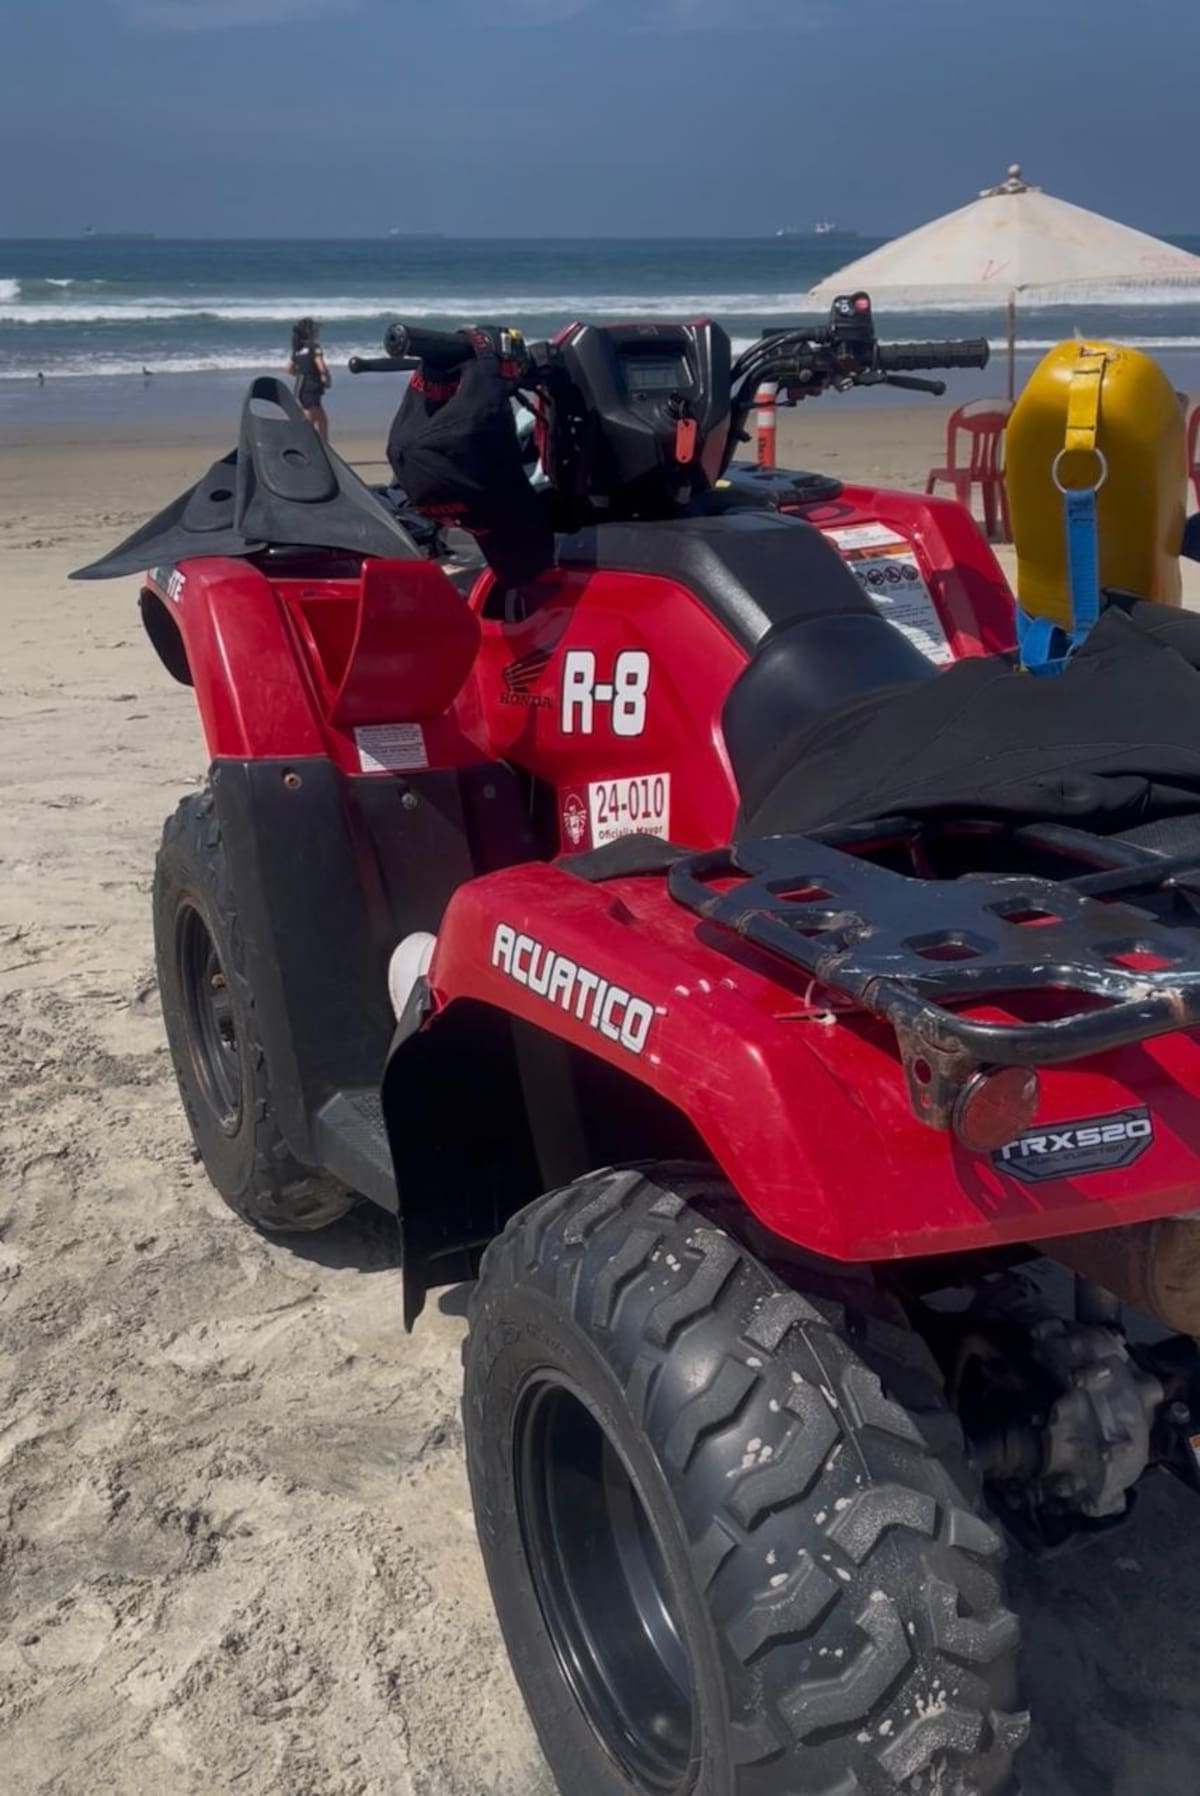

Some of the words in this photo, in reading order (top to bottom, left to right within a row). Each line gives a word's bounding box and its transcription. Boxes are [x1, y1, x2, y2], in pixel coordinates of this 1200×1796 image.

[561, 650, 650, 737] R-8
[596, 776, 665, 824] 24-010
[491, 922, 655, 1054] ACUATICO
